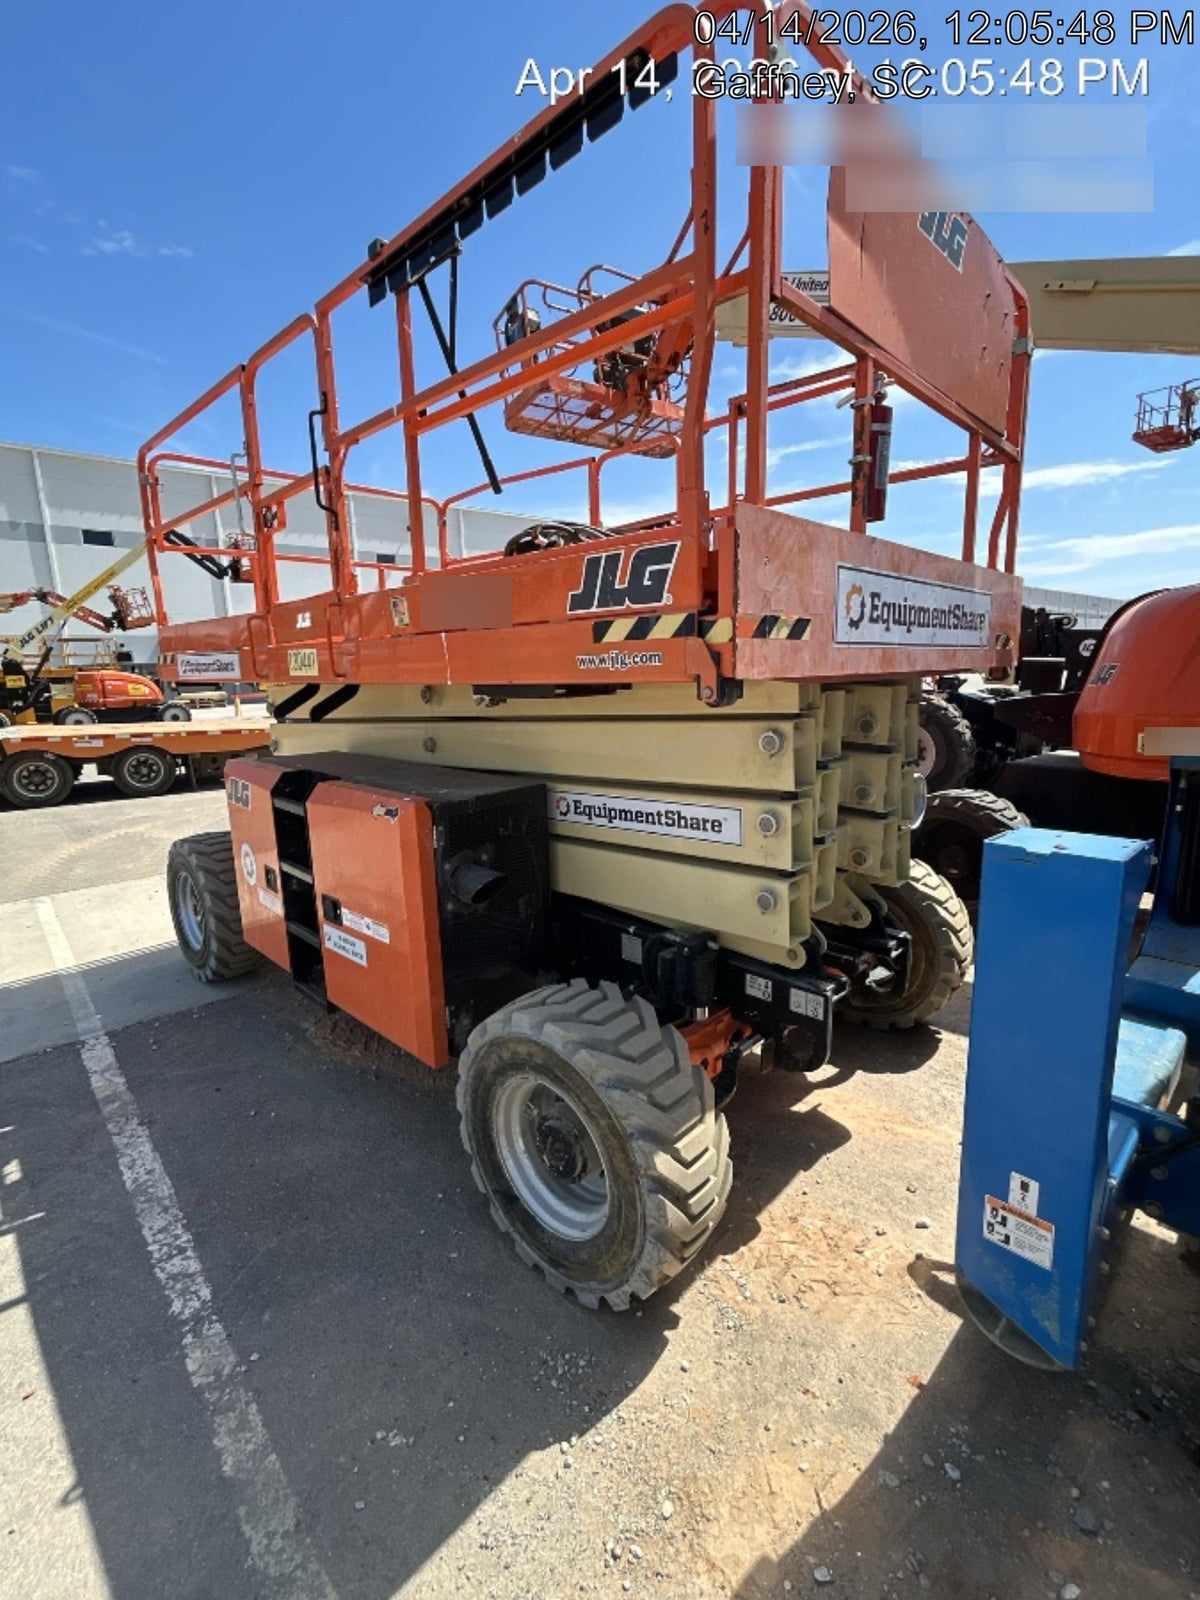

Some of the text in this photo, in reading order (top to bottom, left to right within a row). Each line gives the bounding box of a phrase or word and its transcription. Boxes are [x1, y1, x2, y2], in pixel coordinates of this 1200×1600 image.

[567, 540, 682, 615] JLG
[868, 590, 986, 633] EquipmentShare
[576, 650, 663, 670] www.jlg.com
[228, 777, 251, 810] JLG
[572, 799, 723, 834] EquipmentShare
